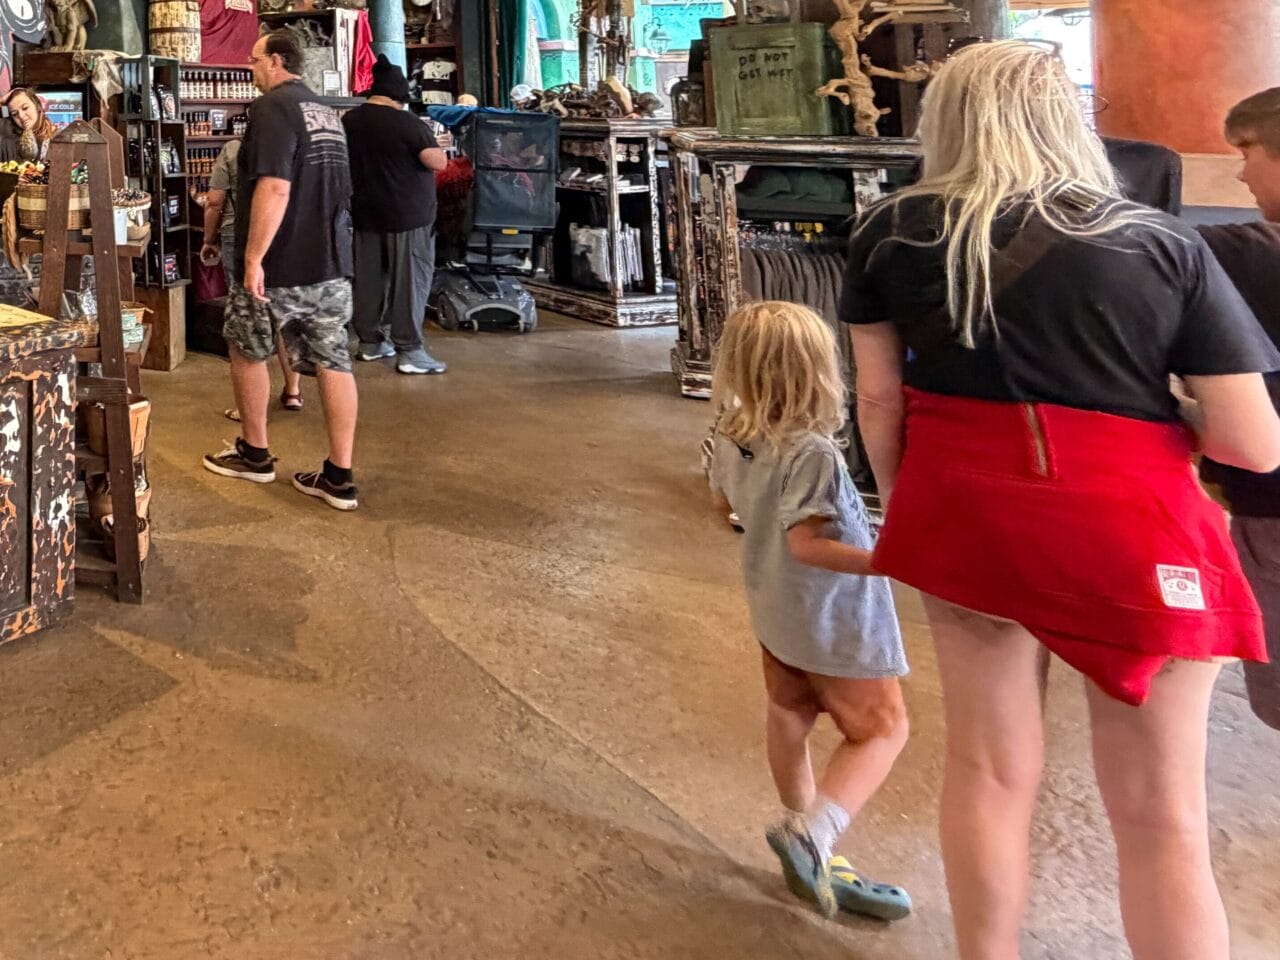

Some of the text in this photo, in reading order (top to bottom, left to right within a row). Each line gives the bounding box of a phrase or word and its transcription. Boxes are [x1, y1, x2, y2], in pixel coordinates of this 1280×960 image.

[738, 52, 789, 66] DO NOT
[738, 68, 794, 80] GET WET
